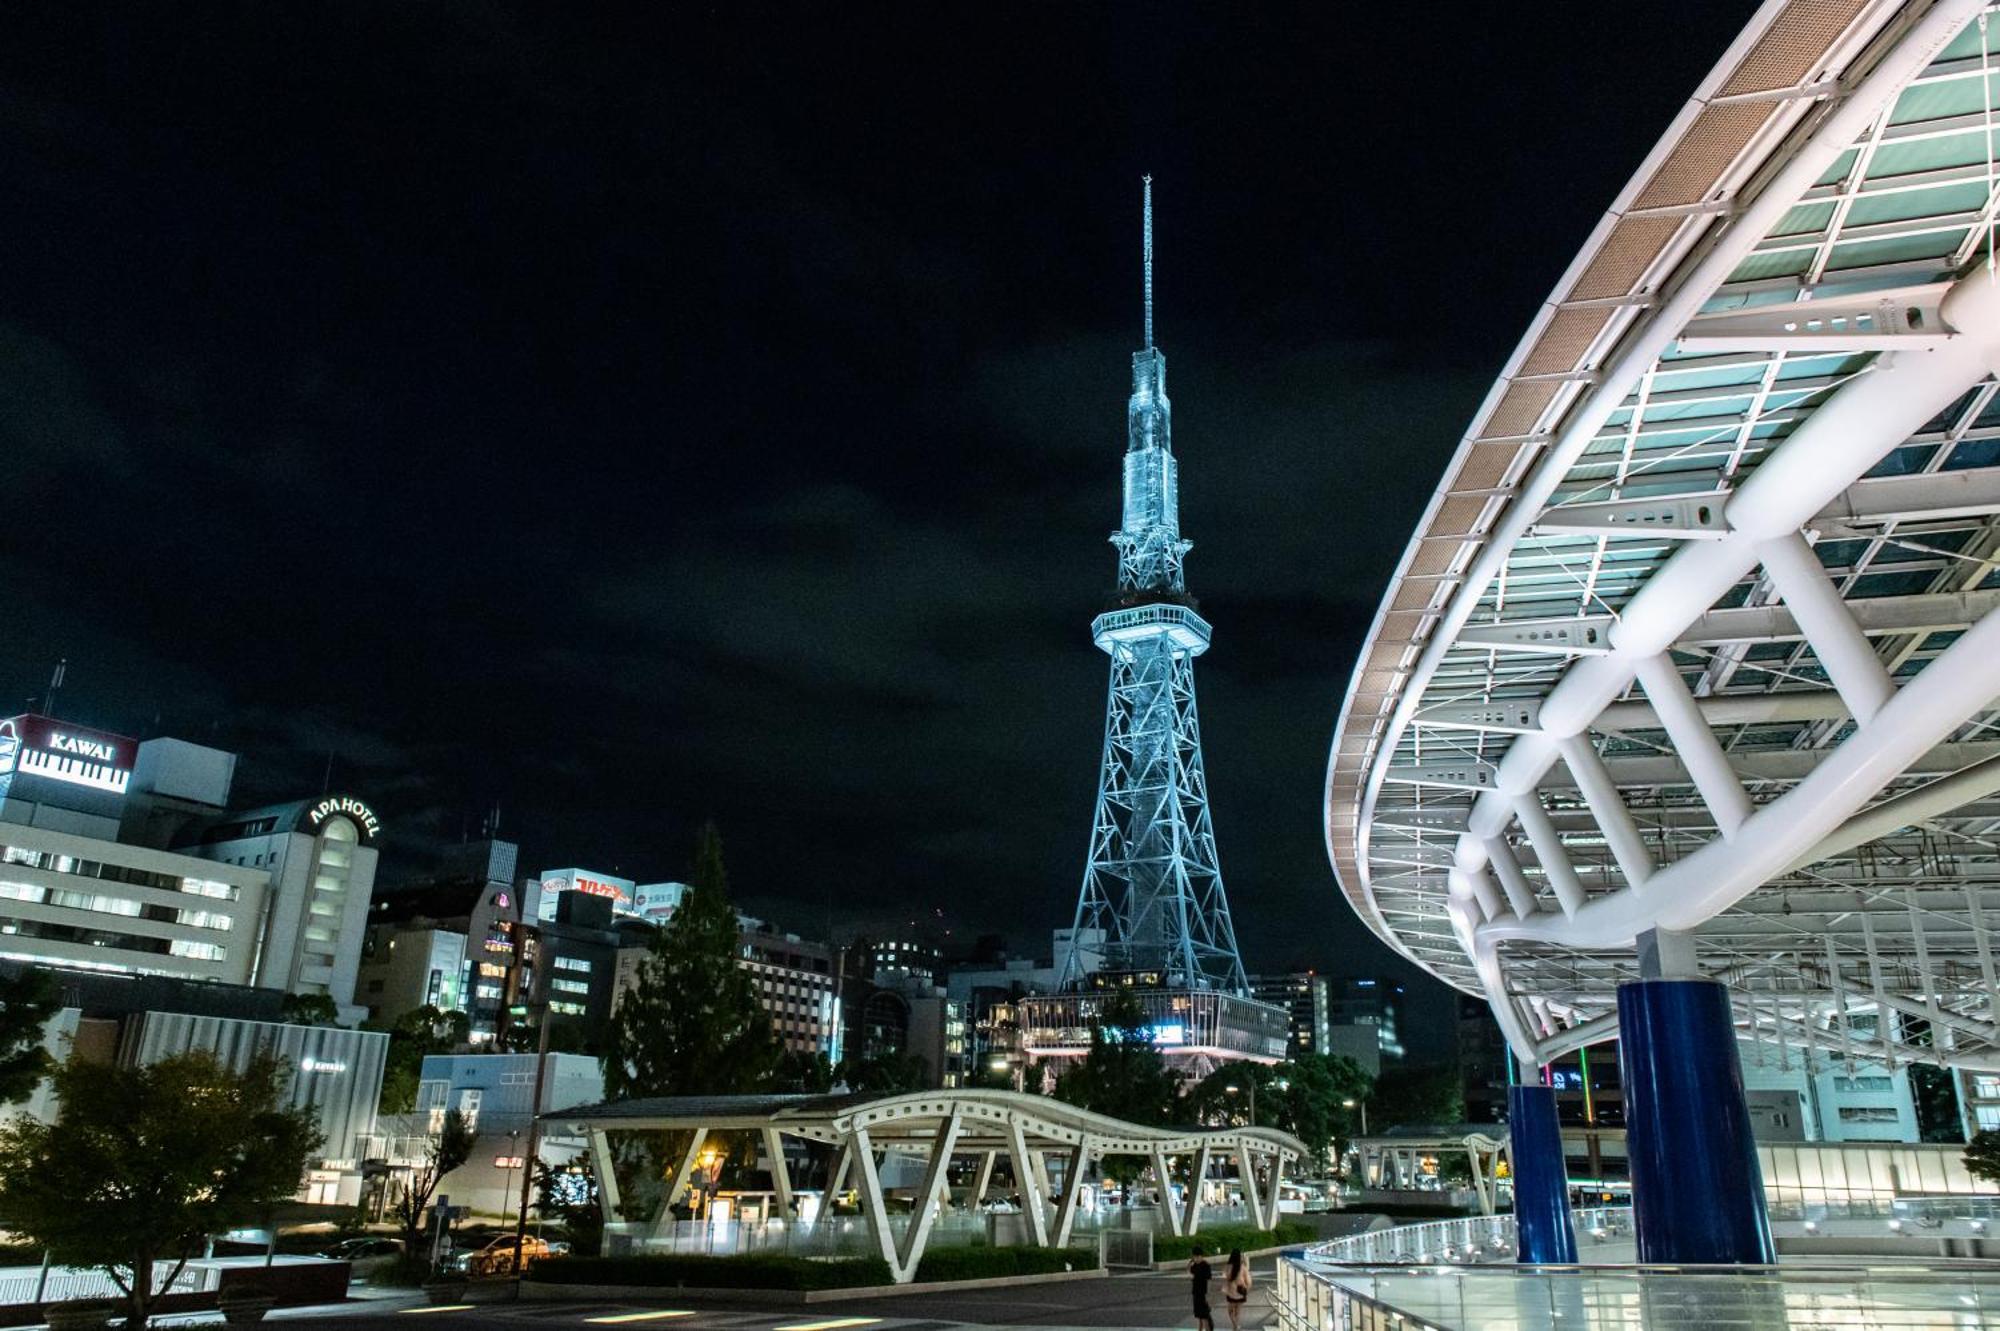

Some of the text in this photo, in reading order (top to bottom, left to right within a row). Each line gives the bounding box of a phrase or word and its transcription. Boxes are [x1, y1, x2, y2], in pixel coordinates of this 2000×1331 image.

[50, 733, 115, 761] KAWAI
[310, 797, 380, 838] APA HOTEL
